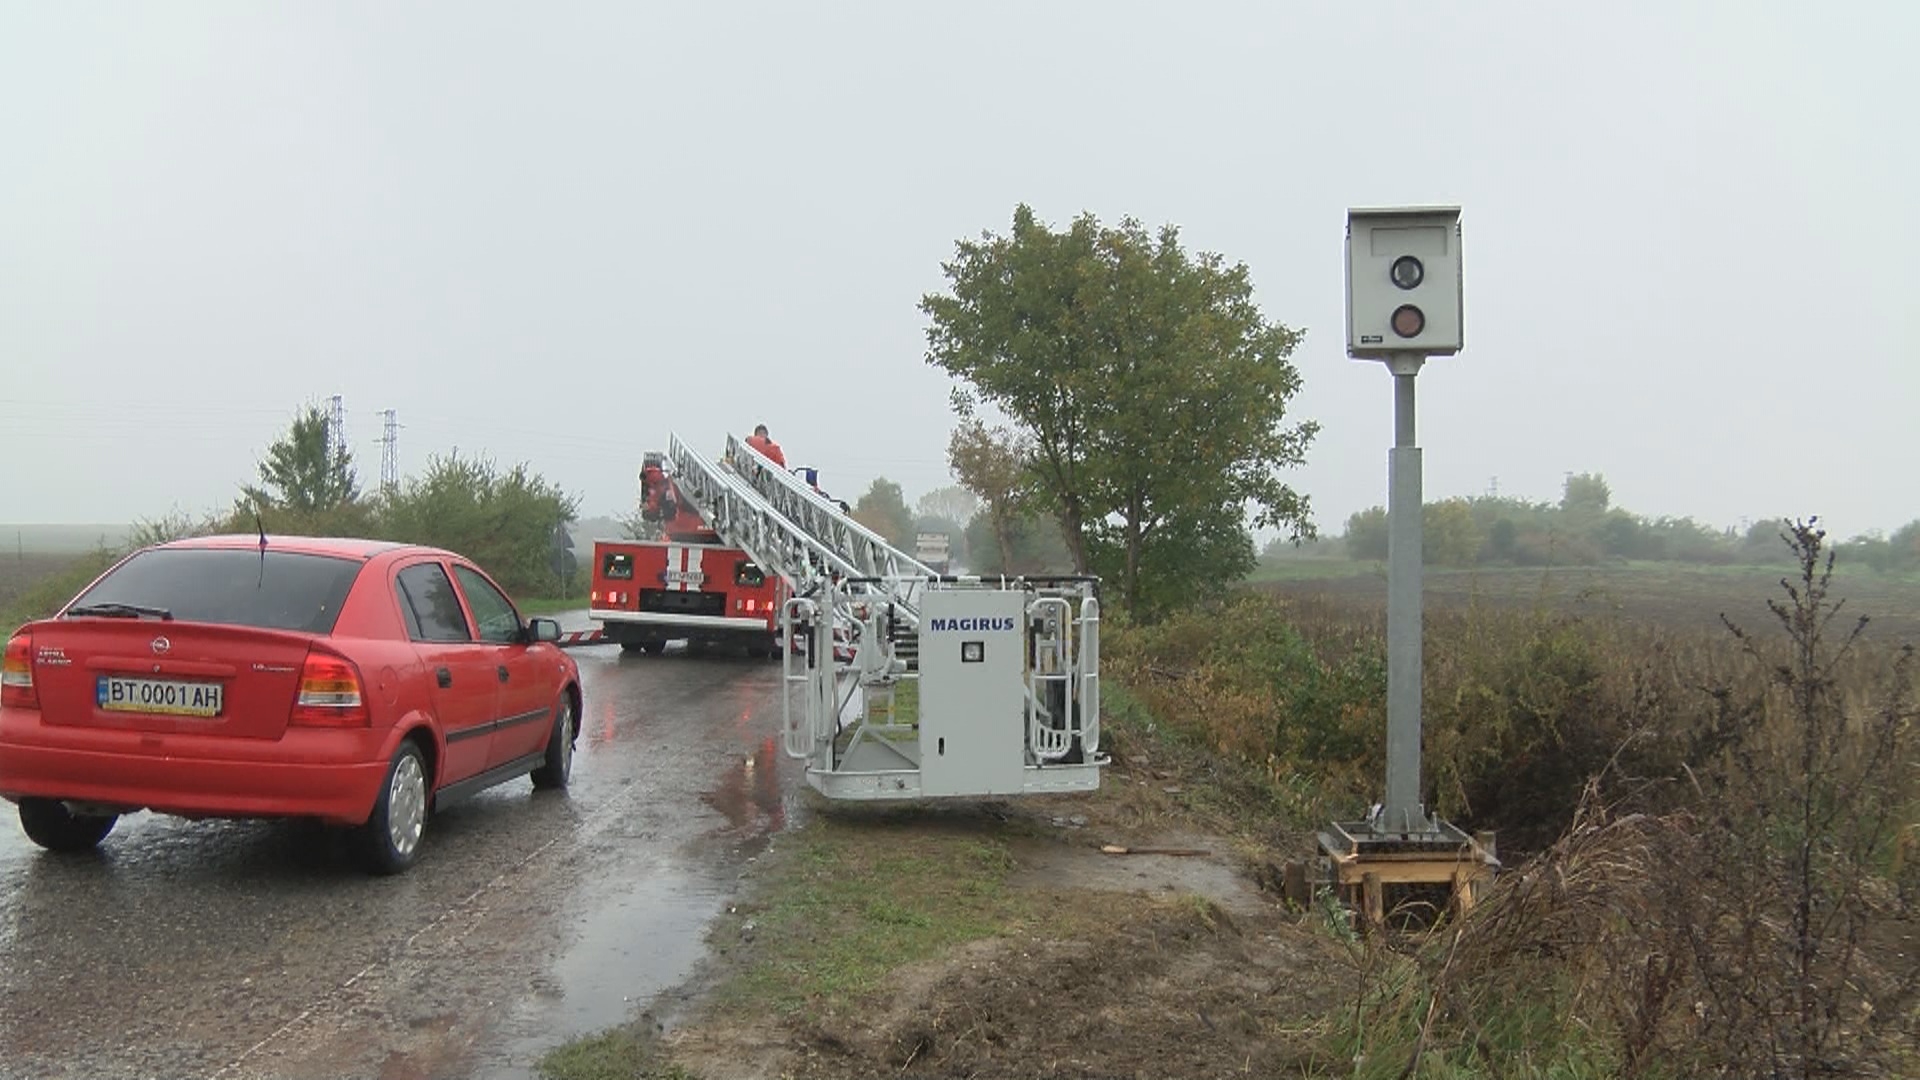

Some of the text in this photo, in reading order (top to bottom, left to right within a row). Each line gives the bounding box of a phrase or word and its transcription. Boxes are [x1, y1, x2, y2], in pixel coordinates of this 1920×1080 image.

[931, 617, 1014, 631] MAGIRUS
[111, 681, 218, 707] BT 0001 AH
